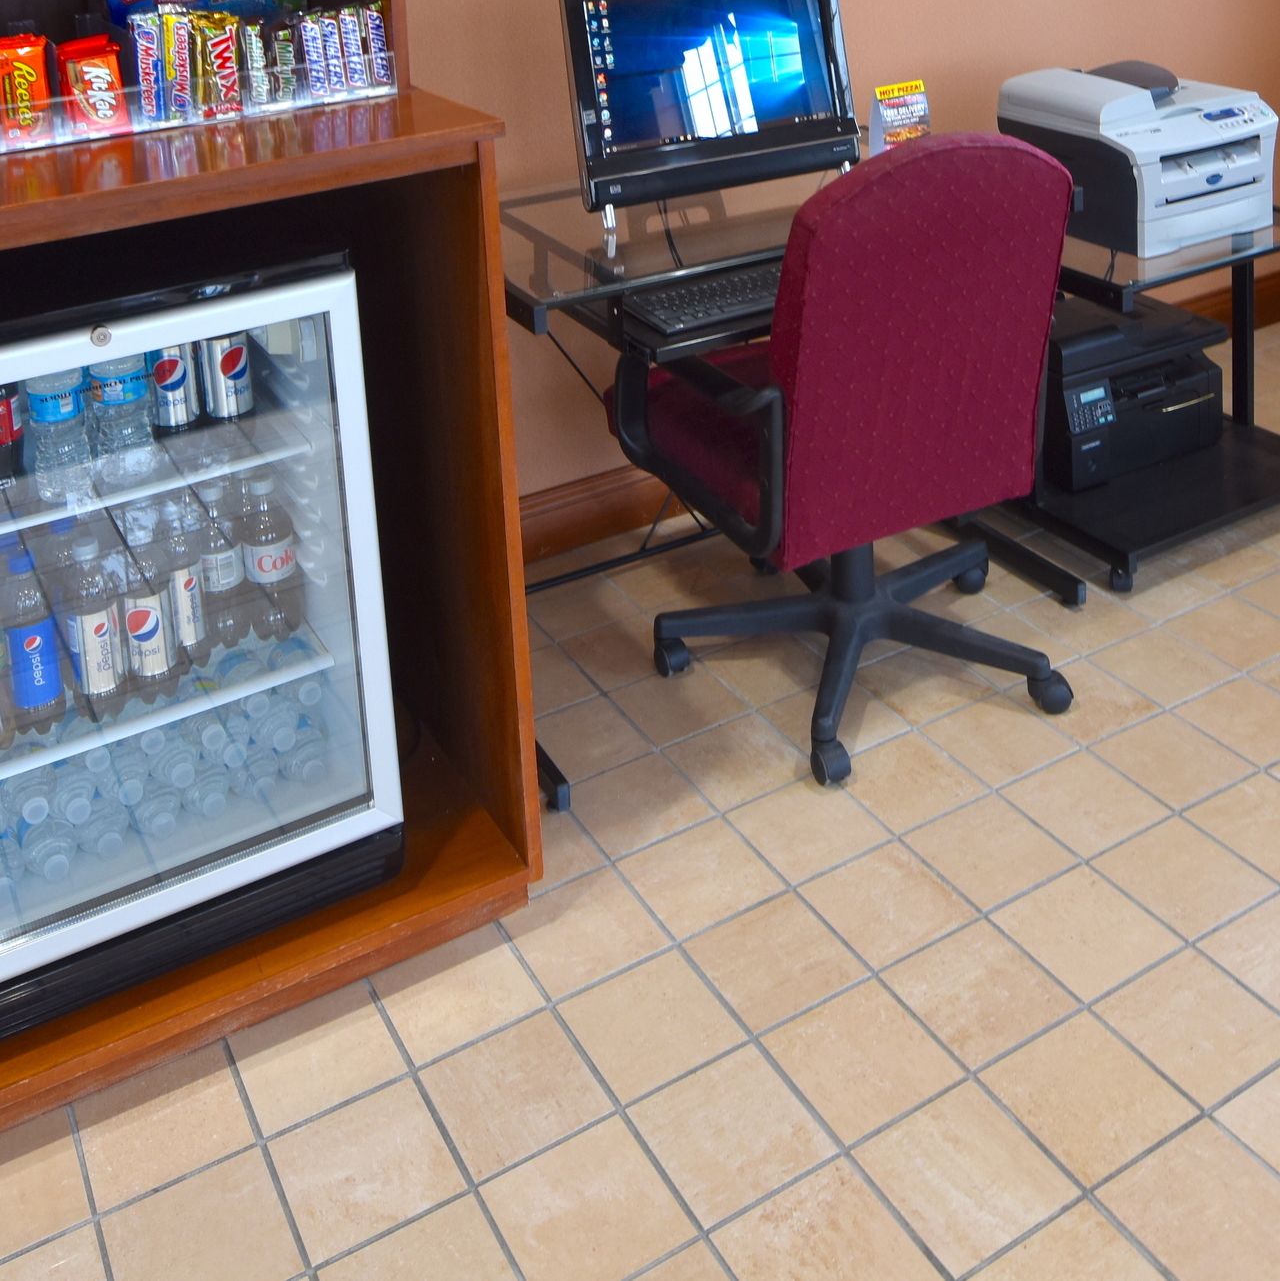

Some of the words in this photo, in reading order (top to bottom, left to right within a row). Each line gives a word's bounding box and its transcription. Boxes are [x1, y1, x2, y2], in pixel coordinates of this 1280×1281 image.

[367, 10, 392, 84] SNICKERS
[256, 548, 296, 574] Cok
[29, 652, 46, 687] pepsi
[100, 639, 113, 672] pepsi
